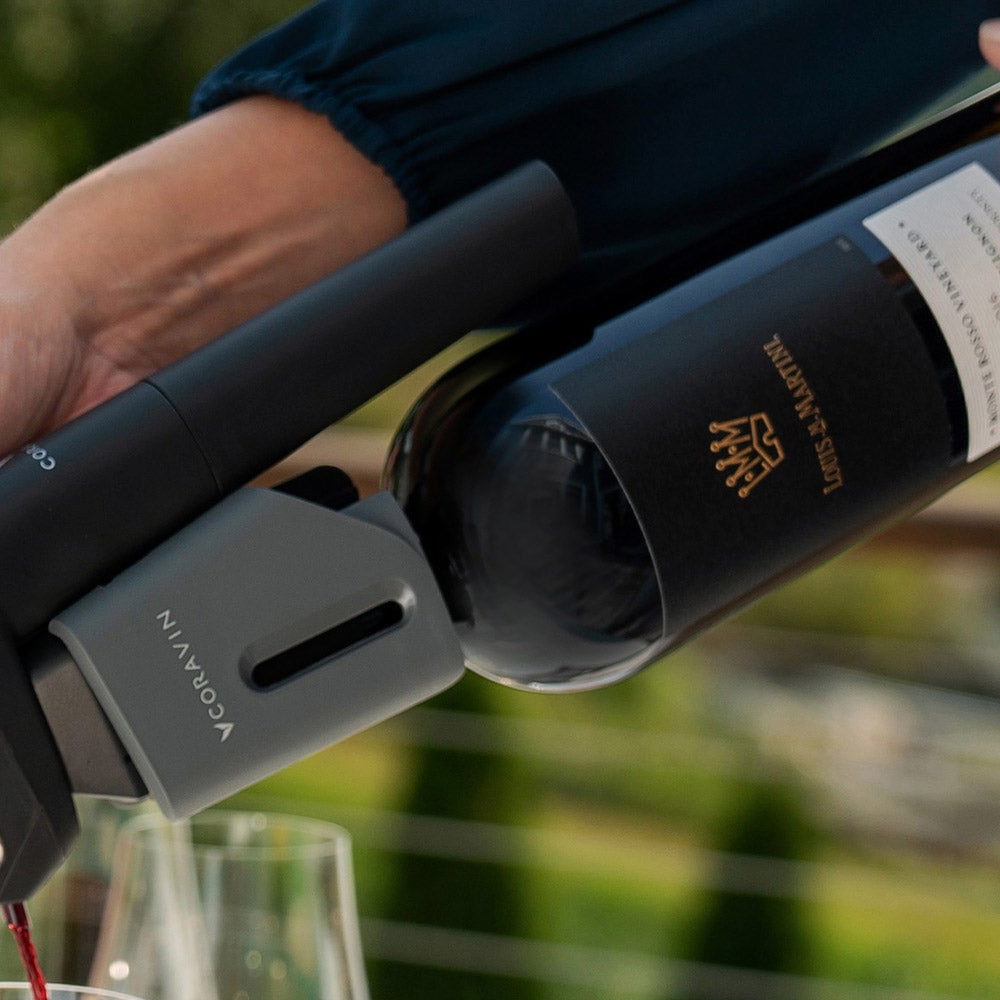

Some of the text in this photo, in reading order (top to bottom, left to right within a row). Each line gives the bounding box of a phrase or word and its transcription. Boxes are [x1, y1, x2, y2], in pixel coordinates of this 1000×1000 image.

[907, 230, 965, 313] VINEYARD
[763, 337, 820, 420] MARTINI
[962, 313, 989, 368] ROSSO
[814, 436, 844, 496] LOUIS
[156, 609, 225, 720] CORAVIN
